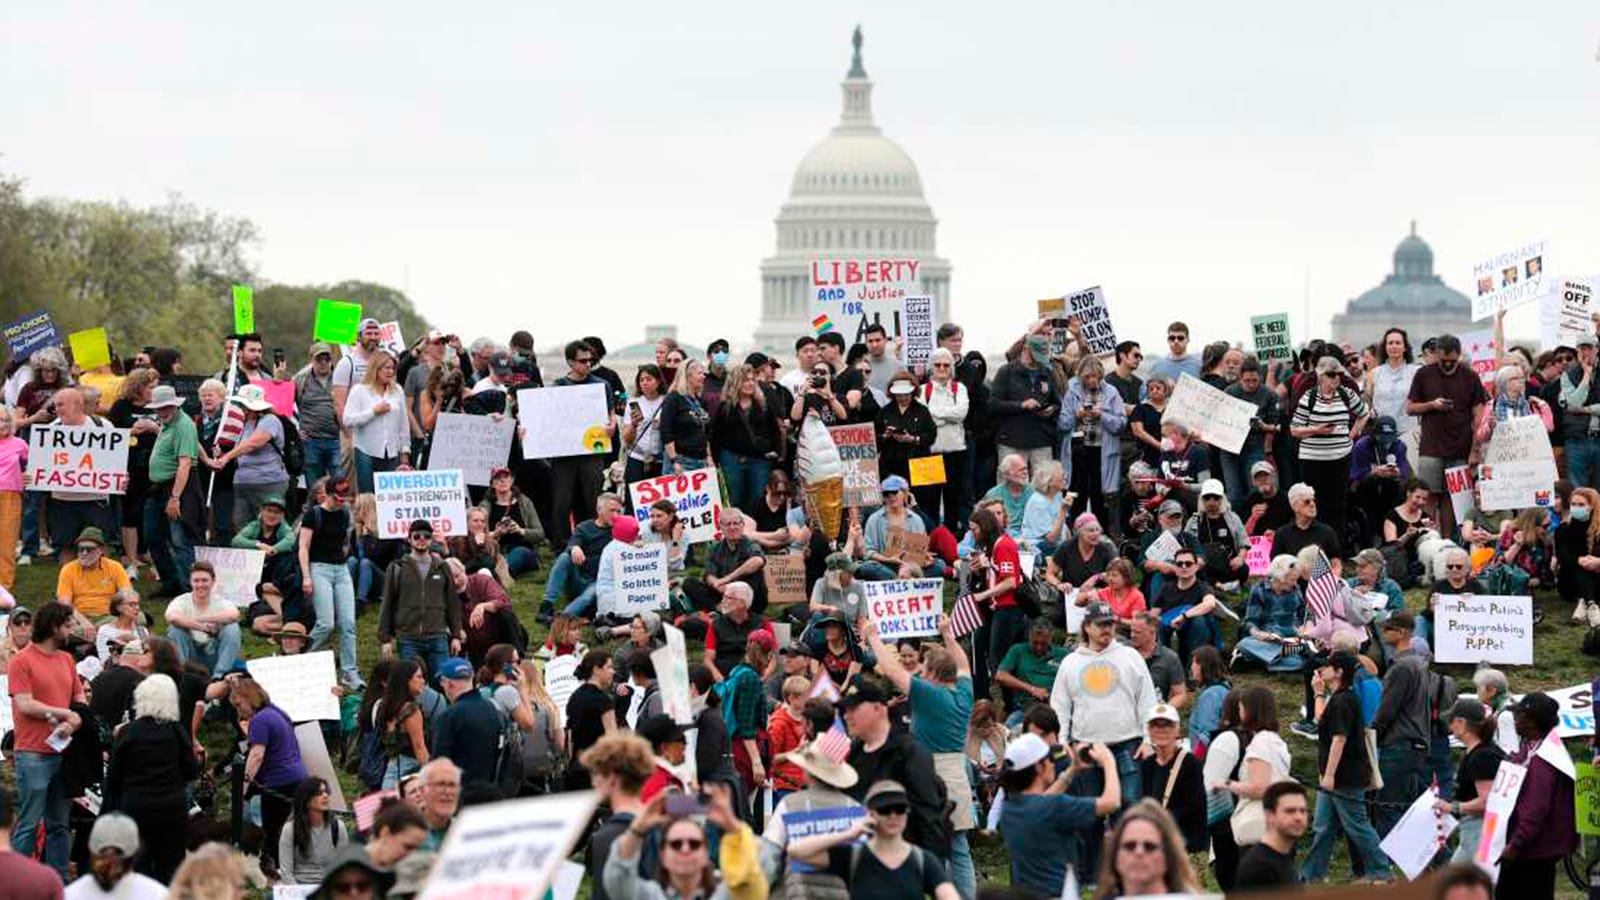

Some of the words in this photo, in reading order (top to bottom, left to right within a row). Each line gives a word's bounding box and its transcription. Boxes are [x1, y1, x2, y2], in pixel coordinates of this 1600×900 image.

[813, 261, 919, 286] LIBERTY
[1070, 292, 1096, 311] STOP
[1564, 291, 1590, 304] OFF
[1096, 320, 1112, 336] ON
[35, 428, 123, 450] TRUMP
[54, 452, 69, 465] IS
[79, 452, 93, 470] A
[34, 468, 126, 491] FASCIST
[378, 474, 458, 489] DIVERSITY
[404, 489, 462, 502] STRENGTH
[636, 473, 707, 504] STOP
[395, 507, 441, 519] STAND
[387, 520, 452, 534] UNED
[866, 583, 877, 596] IS
[883, 581, 908, 594] THIS
[874, 595, 935, 617] GREAT
[877, 618, 908, 634] OOKS
